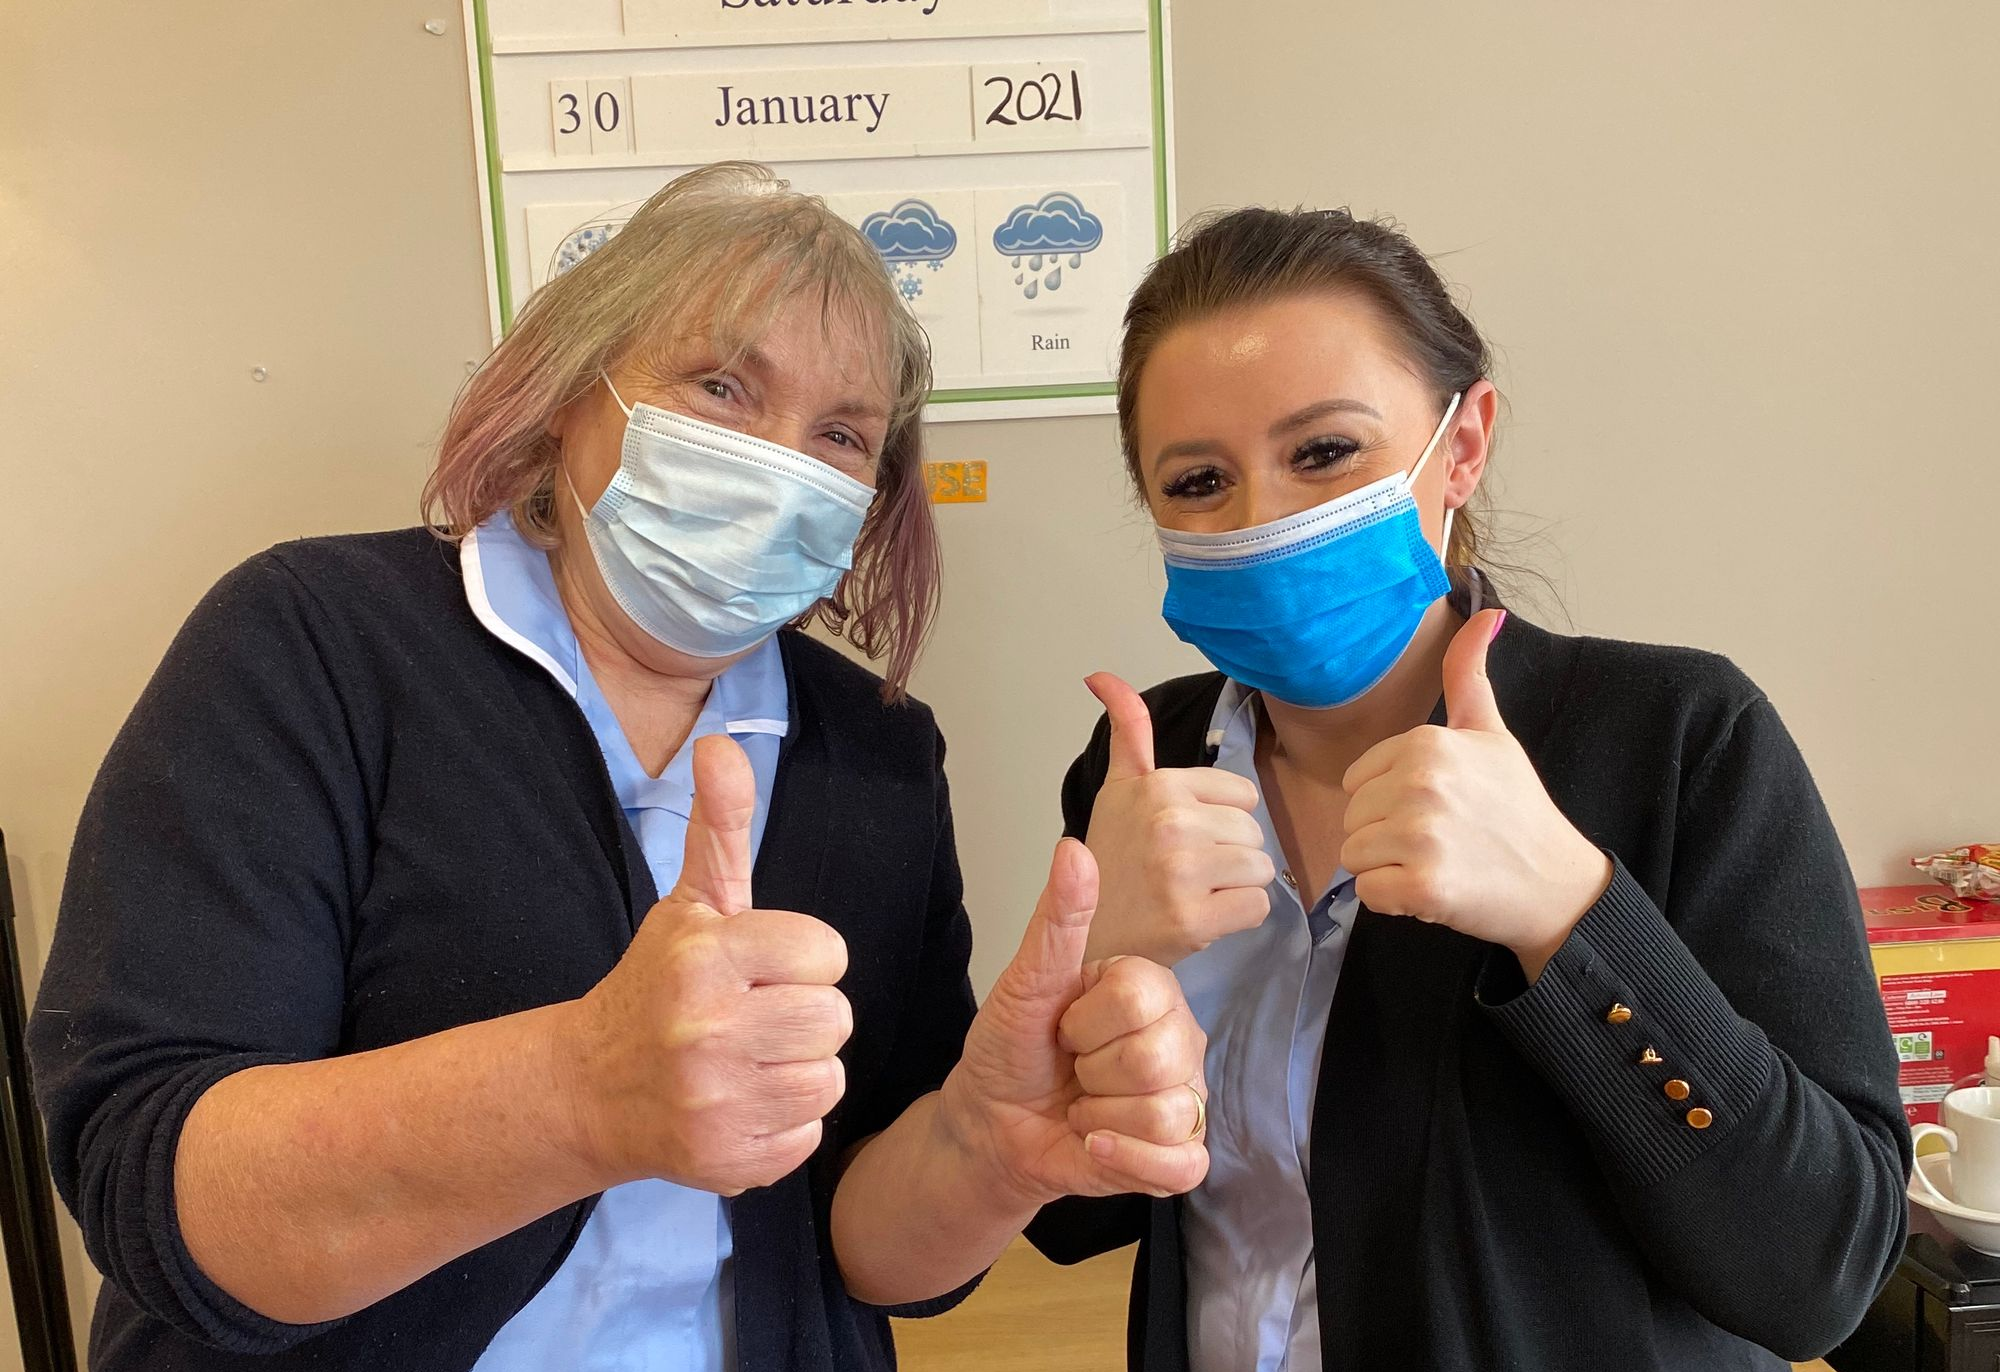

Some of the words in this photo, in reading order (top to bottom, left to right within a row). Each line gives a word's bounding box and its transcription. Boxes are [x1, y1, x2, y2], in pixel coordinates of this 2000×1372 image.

[558, 92, 620, 134] 30
[715, 86, 890, 133] January
[984, 70, 1082, 125] 2021
[1031, 333, 1070, 351] Rain
